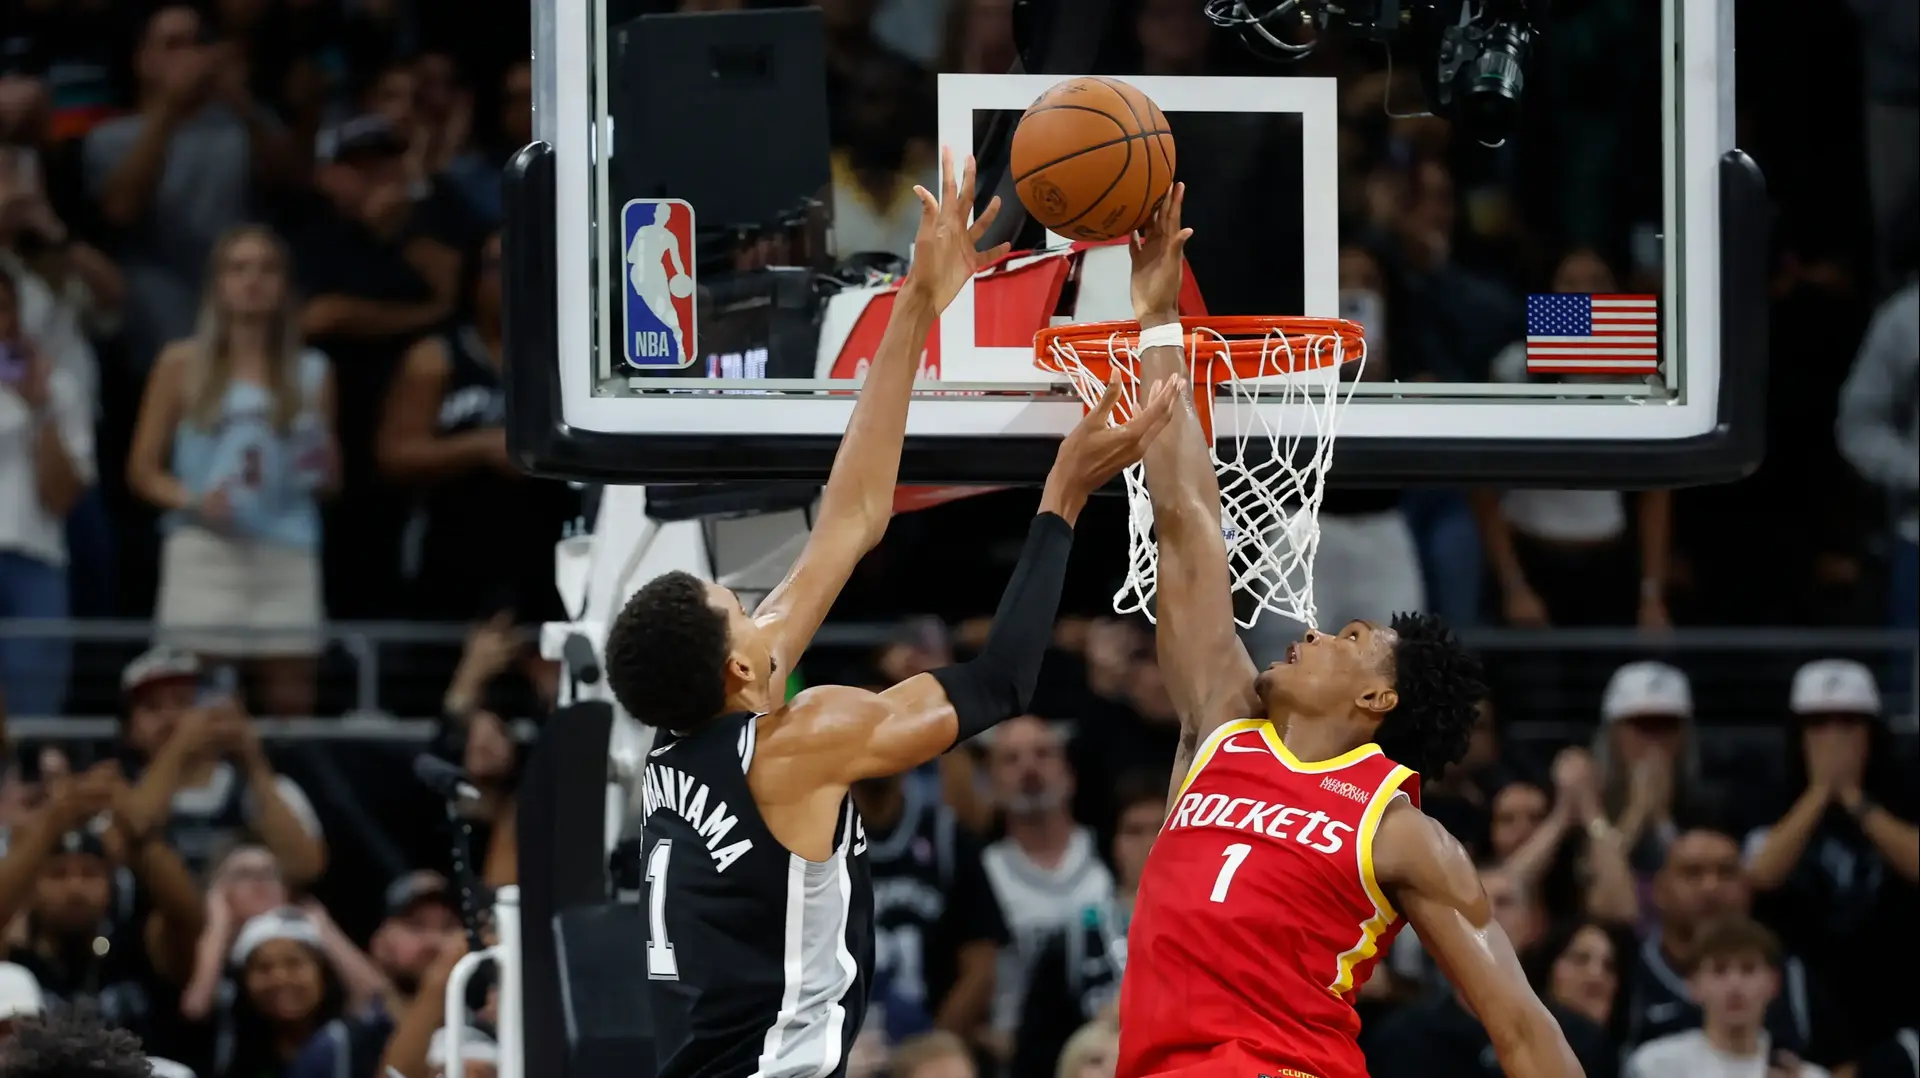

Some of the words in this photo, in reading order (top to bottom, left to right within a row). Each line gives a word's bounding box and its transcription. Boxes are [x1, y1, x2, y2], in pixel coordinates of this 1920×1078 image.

[635, 331, 669, 357] NBA
[1318, 783, 1367, 804] HERMANN
[1321, 776, 1370, 797] MEMORIAL
[1209, 843, 1253, 903] 1
[645, 838, 680, 981] 1
